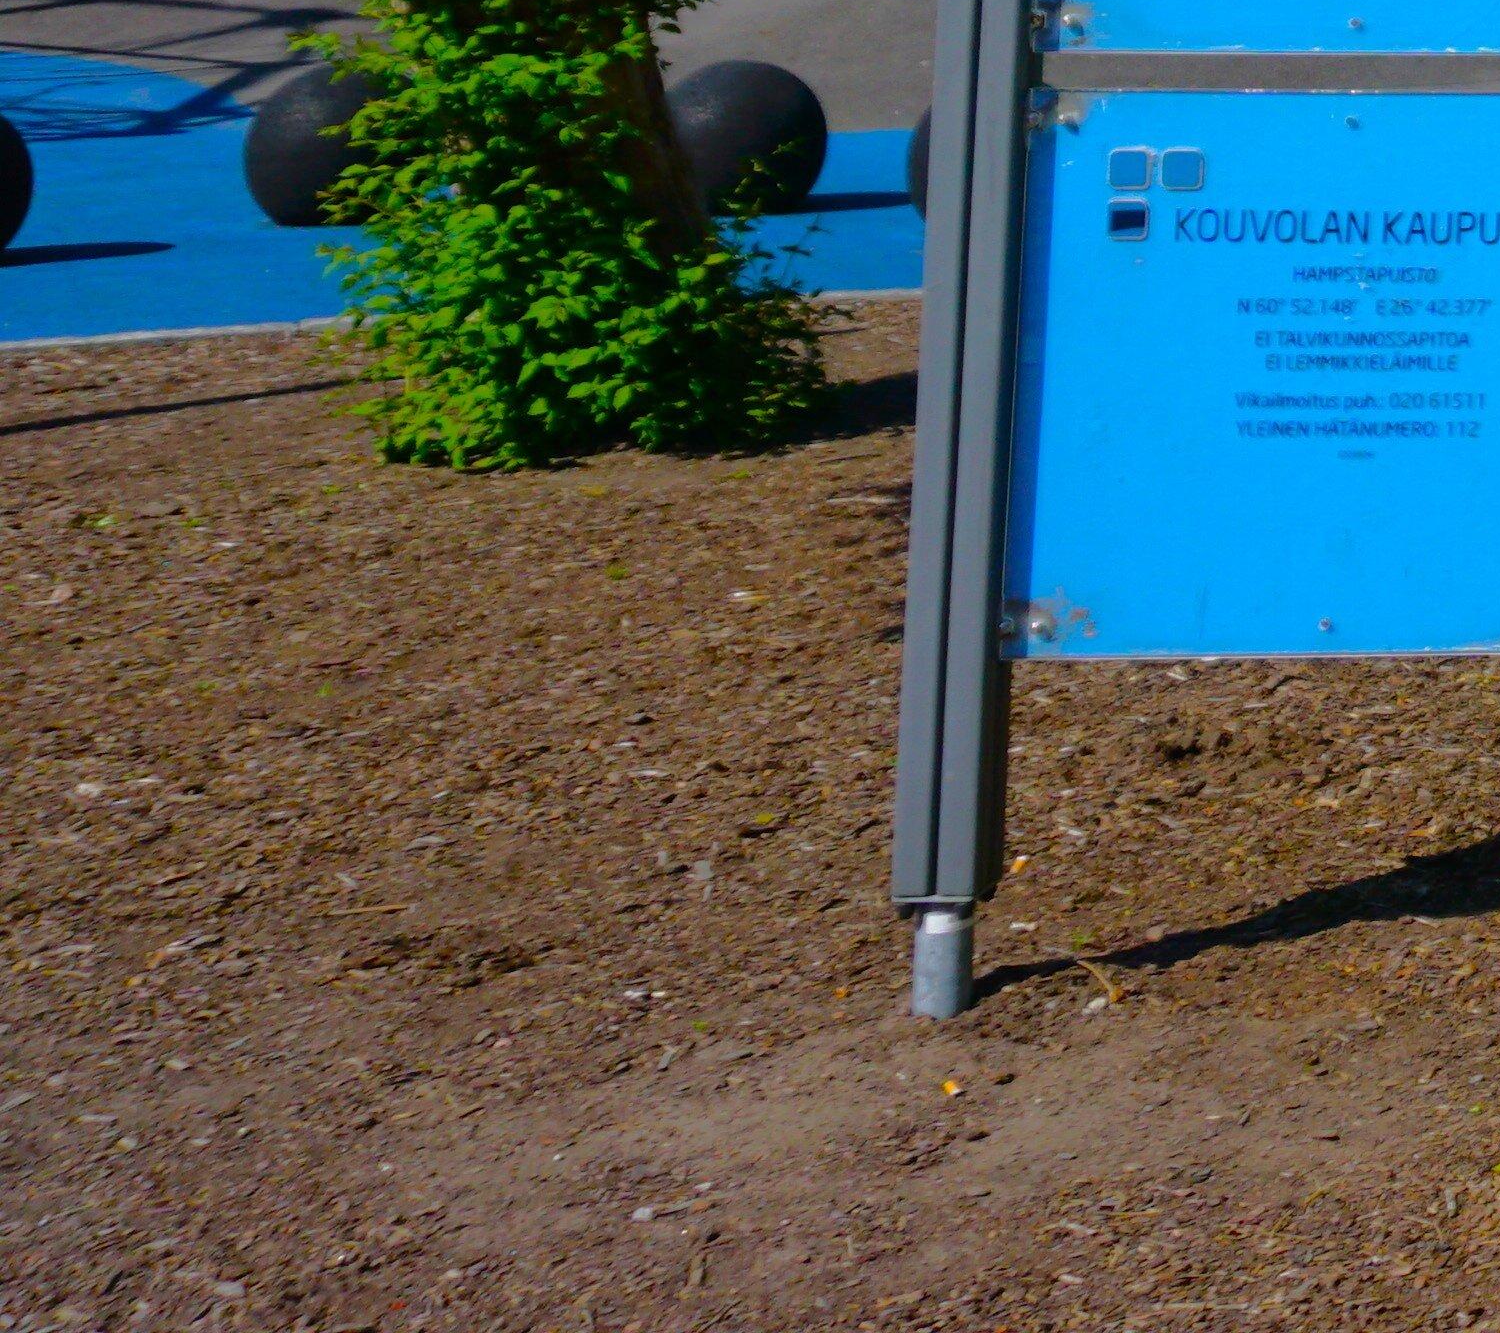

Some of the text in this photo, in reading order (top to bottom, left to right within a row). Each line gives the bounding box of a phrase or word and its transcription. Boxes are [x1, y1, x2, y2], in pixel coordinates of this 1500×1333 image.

[1174, 208, 1370, 245] KOUVOLAN
[1237, 298, 1250, 315] N
[1375, 299, 1386, 315] E
[1254, 330, 1471, 347] EI TALVIKUNNOSSAPITOA
[1265, 353, 1458, 371] EI LEMMIKKIELÄIMILLE
[1234, 391, 1340, 410] Vikailmoitus
[1388, 392, 1423, 410] 020
[1428, 392, 1486, 410] 61511
[1236, 420, 1310, 438] YLEINEN
[1446, 420, 1482, 438] 112
